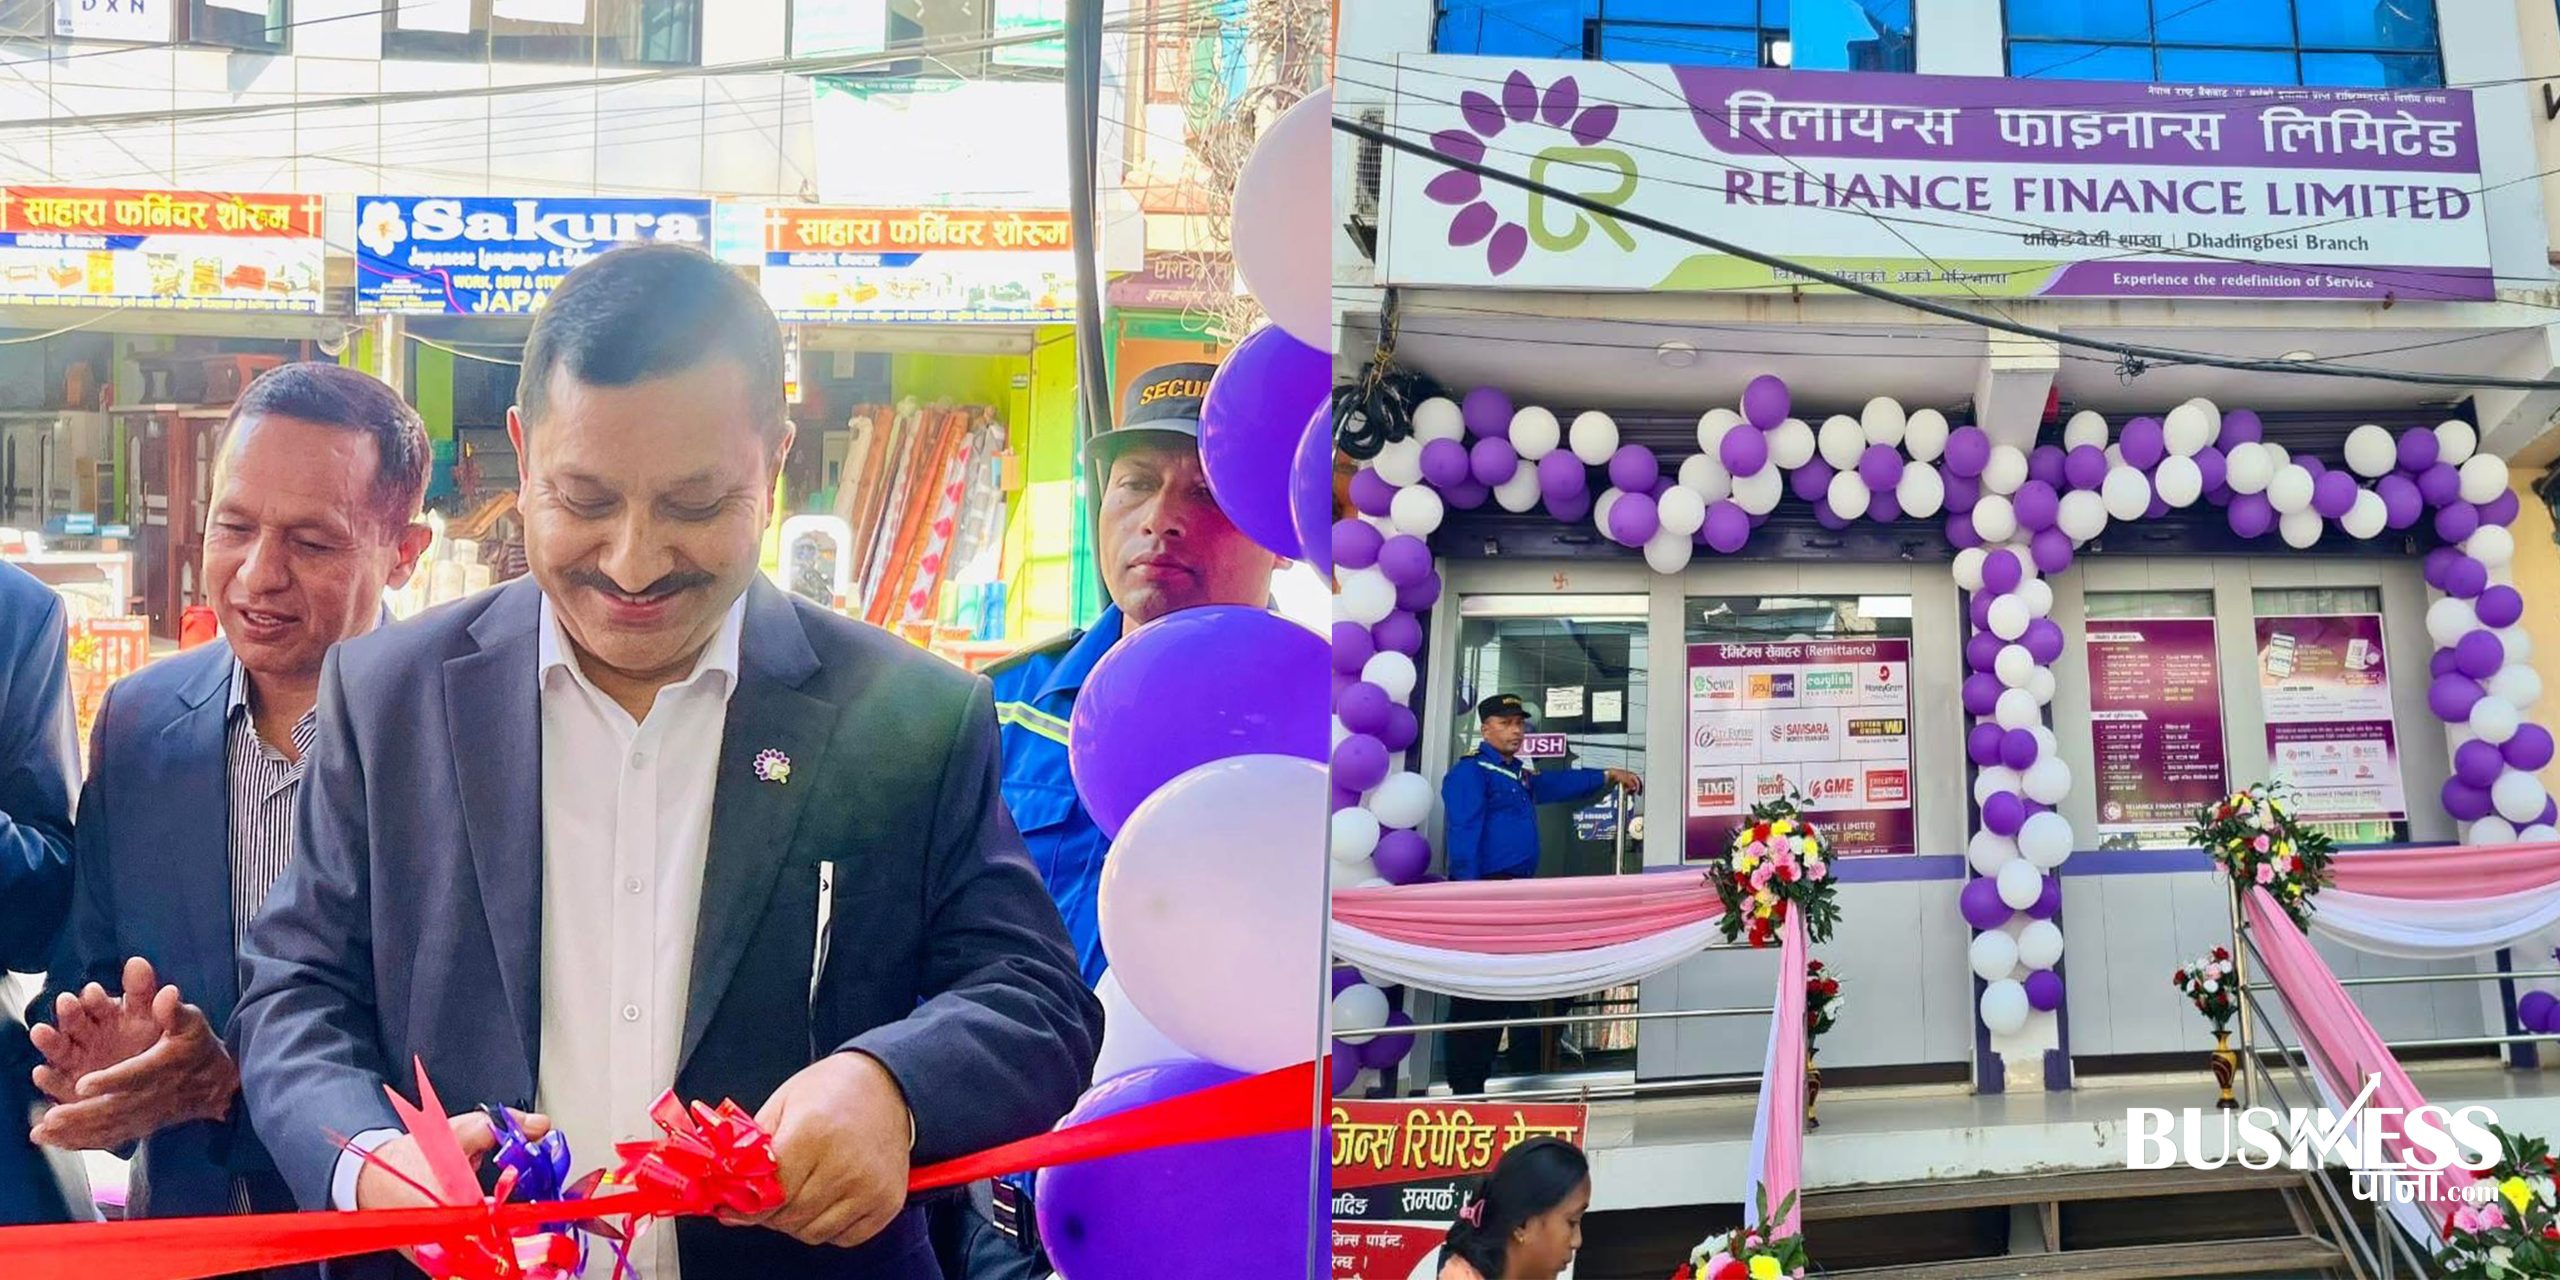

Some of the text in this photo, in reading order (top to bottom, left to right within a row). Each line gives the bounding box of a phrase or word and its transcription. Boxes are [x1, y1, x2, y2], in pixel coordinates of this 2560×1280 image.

[1725, 90, 2463, 158] रिलायन्स फाइनान्स लिमिटेड
[1724, 169, 2471, 222] RELIANCE FINANCE LIMITED
[23, 196, 107, 227] साहारा
[411, 199, 703, 249] Sakura
[796, 217, 881, 247] साहारा
[2187, 232, 2370, 252] Dhadingbesi Branch
[2112, 272, 2190, 288] Experience
[2193, 273, 2217, 287] the
[2220, 273, 2302, 288] redefinition
[2305, 274, 2321, 288] of
[471, 290, 547, 314] JAPA
[1804, 641, 1877, 659] (Remittance)
[1523, 738, 1564, 752] USH
[1824, 778, 1855, 793] GME
[1401, 1108, 1497, 1171] रिपेरिङ
